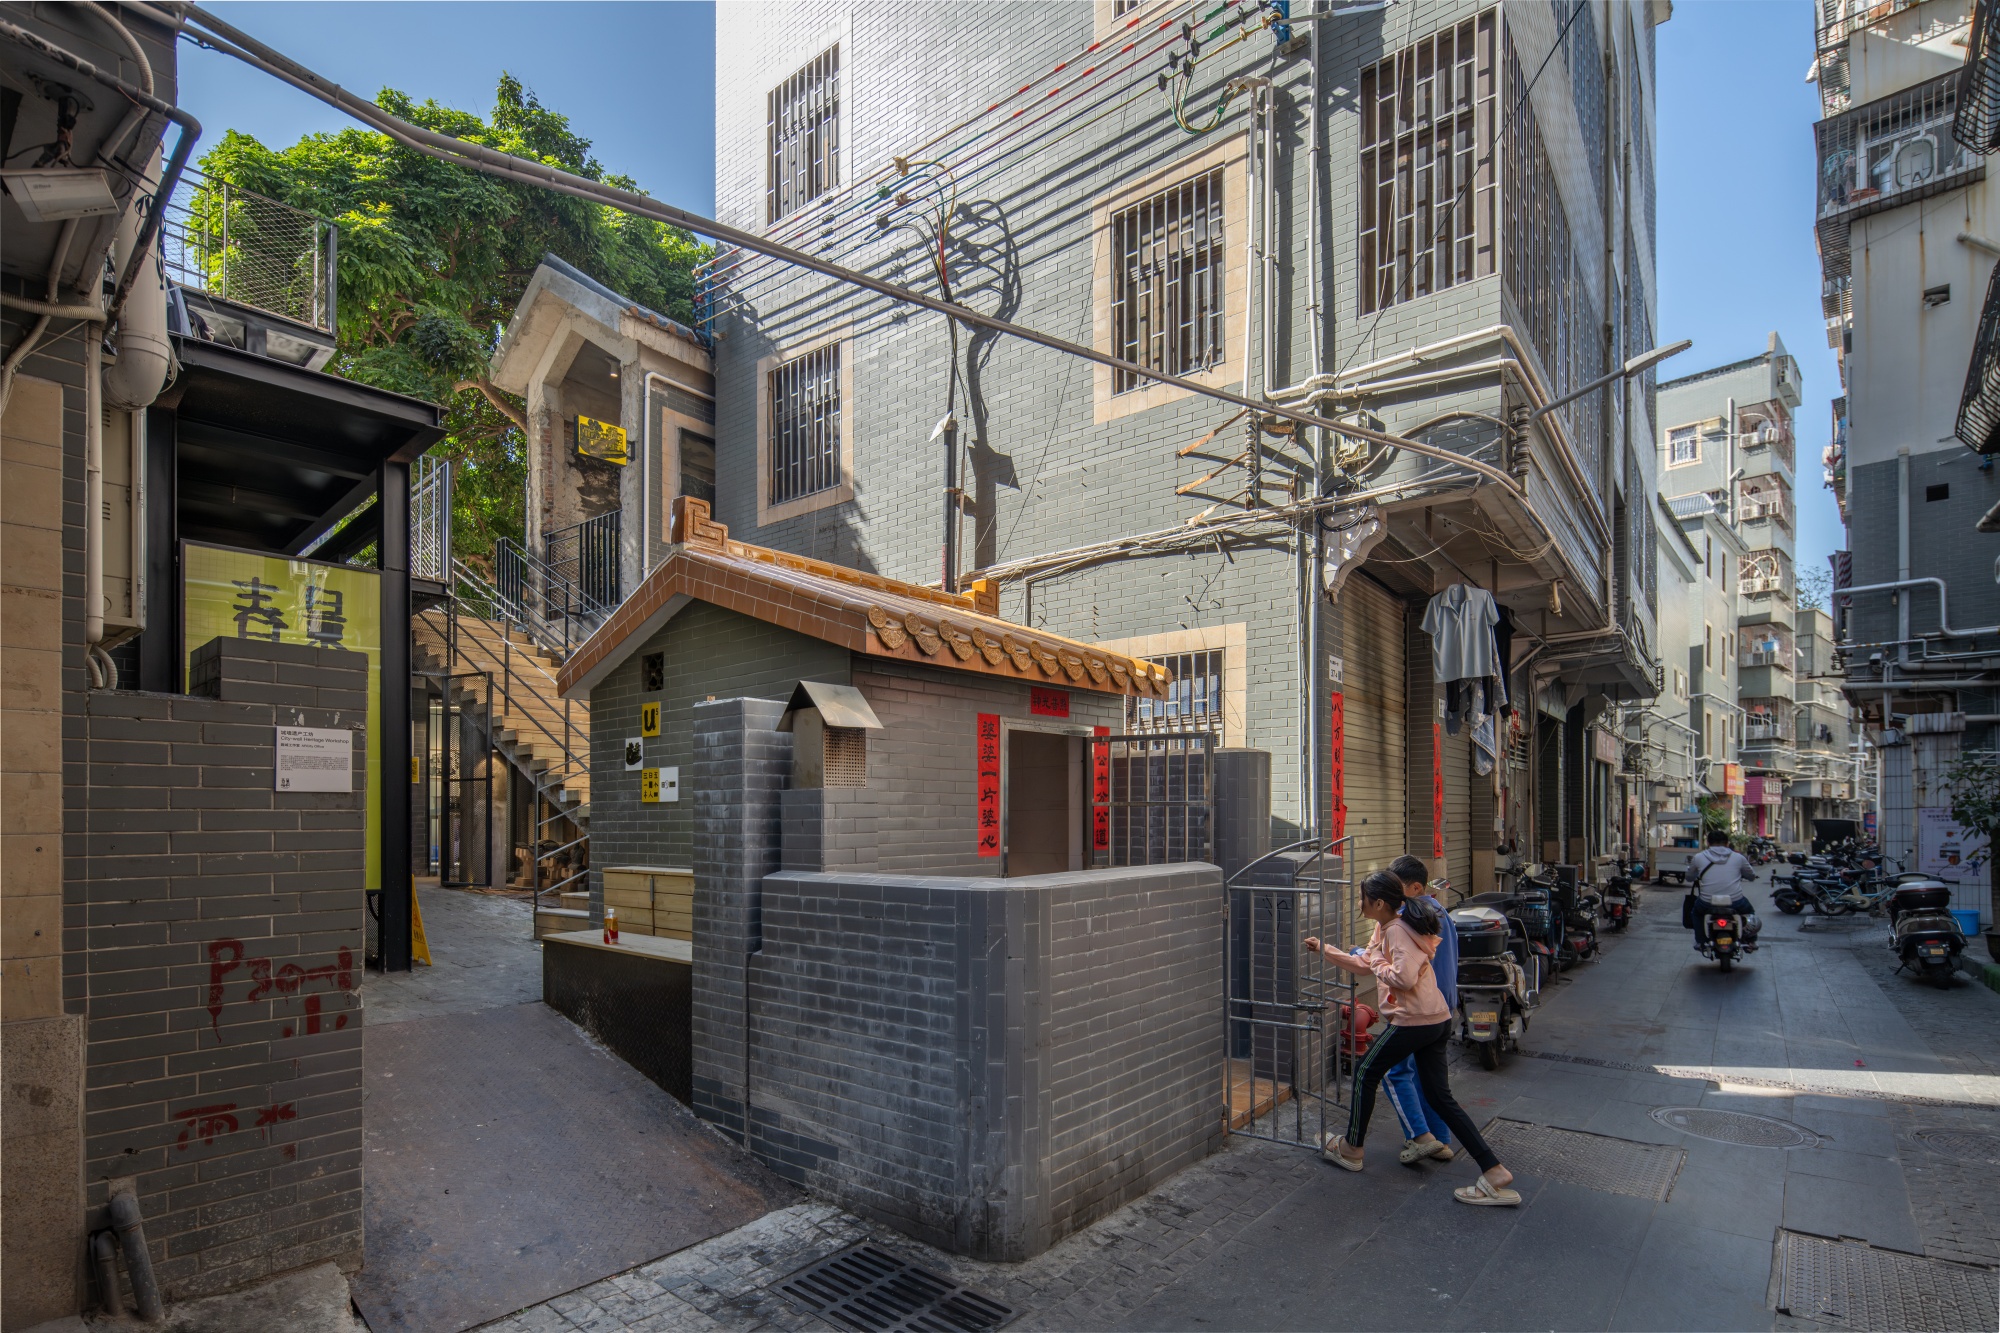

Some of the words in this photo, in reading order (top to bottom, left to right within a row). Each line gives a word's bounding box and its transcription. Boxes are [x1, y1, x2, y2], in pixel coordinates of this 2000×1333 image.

[980, 721, 998, 849] 婆婆一片婆心
